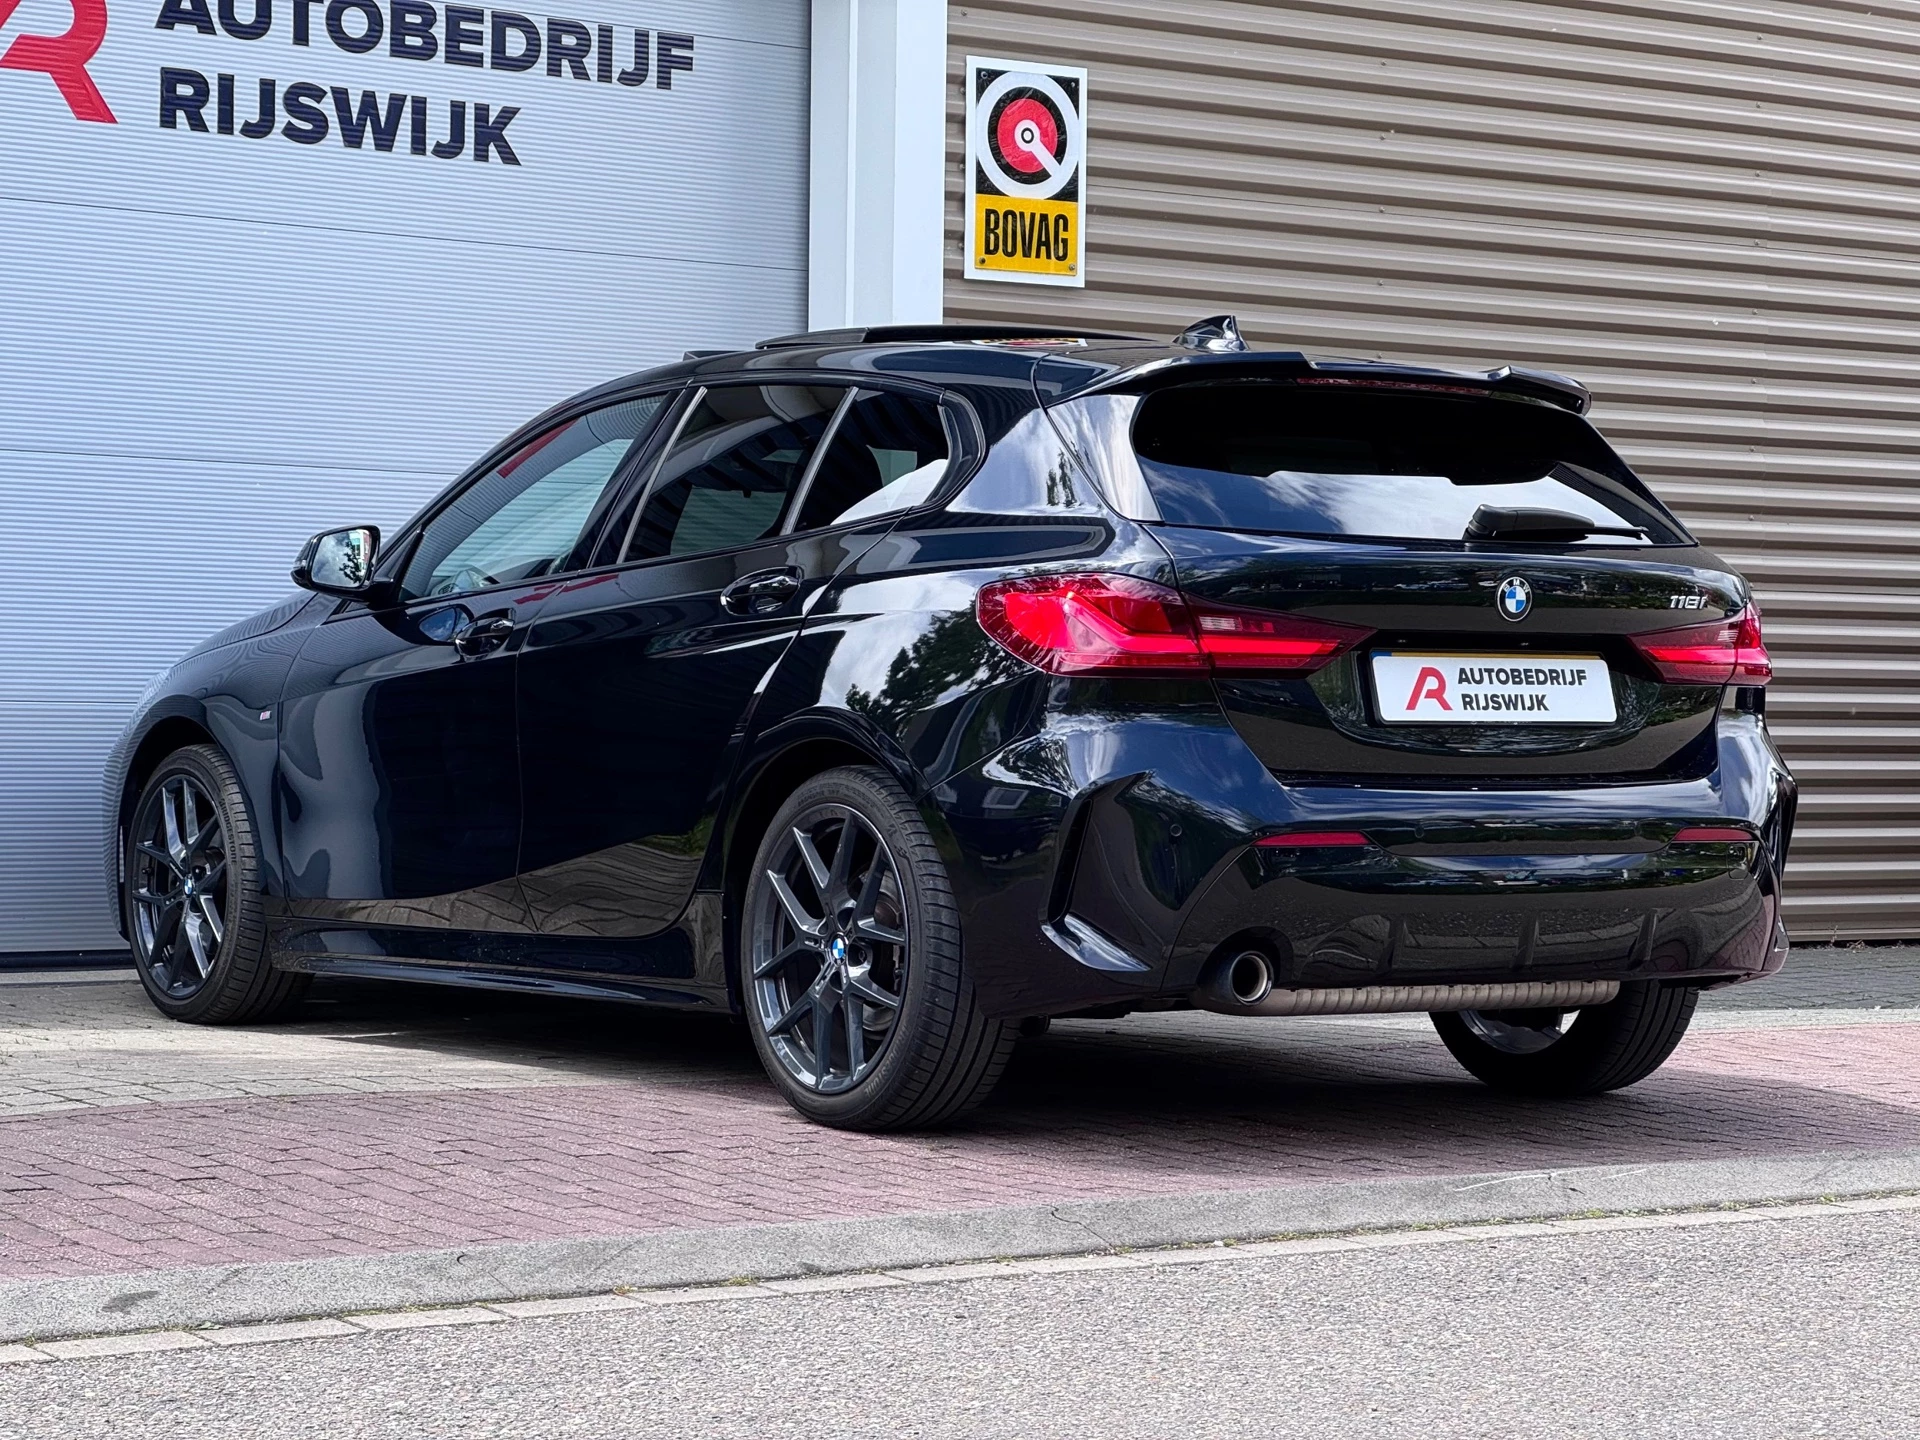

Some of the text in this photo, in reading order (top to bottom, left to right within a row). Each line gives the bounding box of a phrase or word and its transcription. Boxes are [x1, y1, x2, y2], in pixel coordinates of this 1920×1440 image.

[158, 66, 522, 166] RIJSWIJK
[984, 208, 1069, 262] BOVAG
[1457, 667, 1588, 687] AUTOBEDRIJF
[1461, 693, 1550, 712] RIJSWIJK
